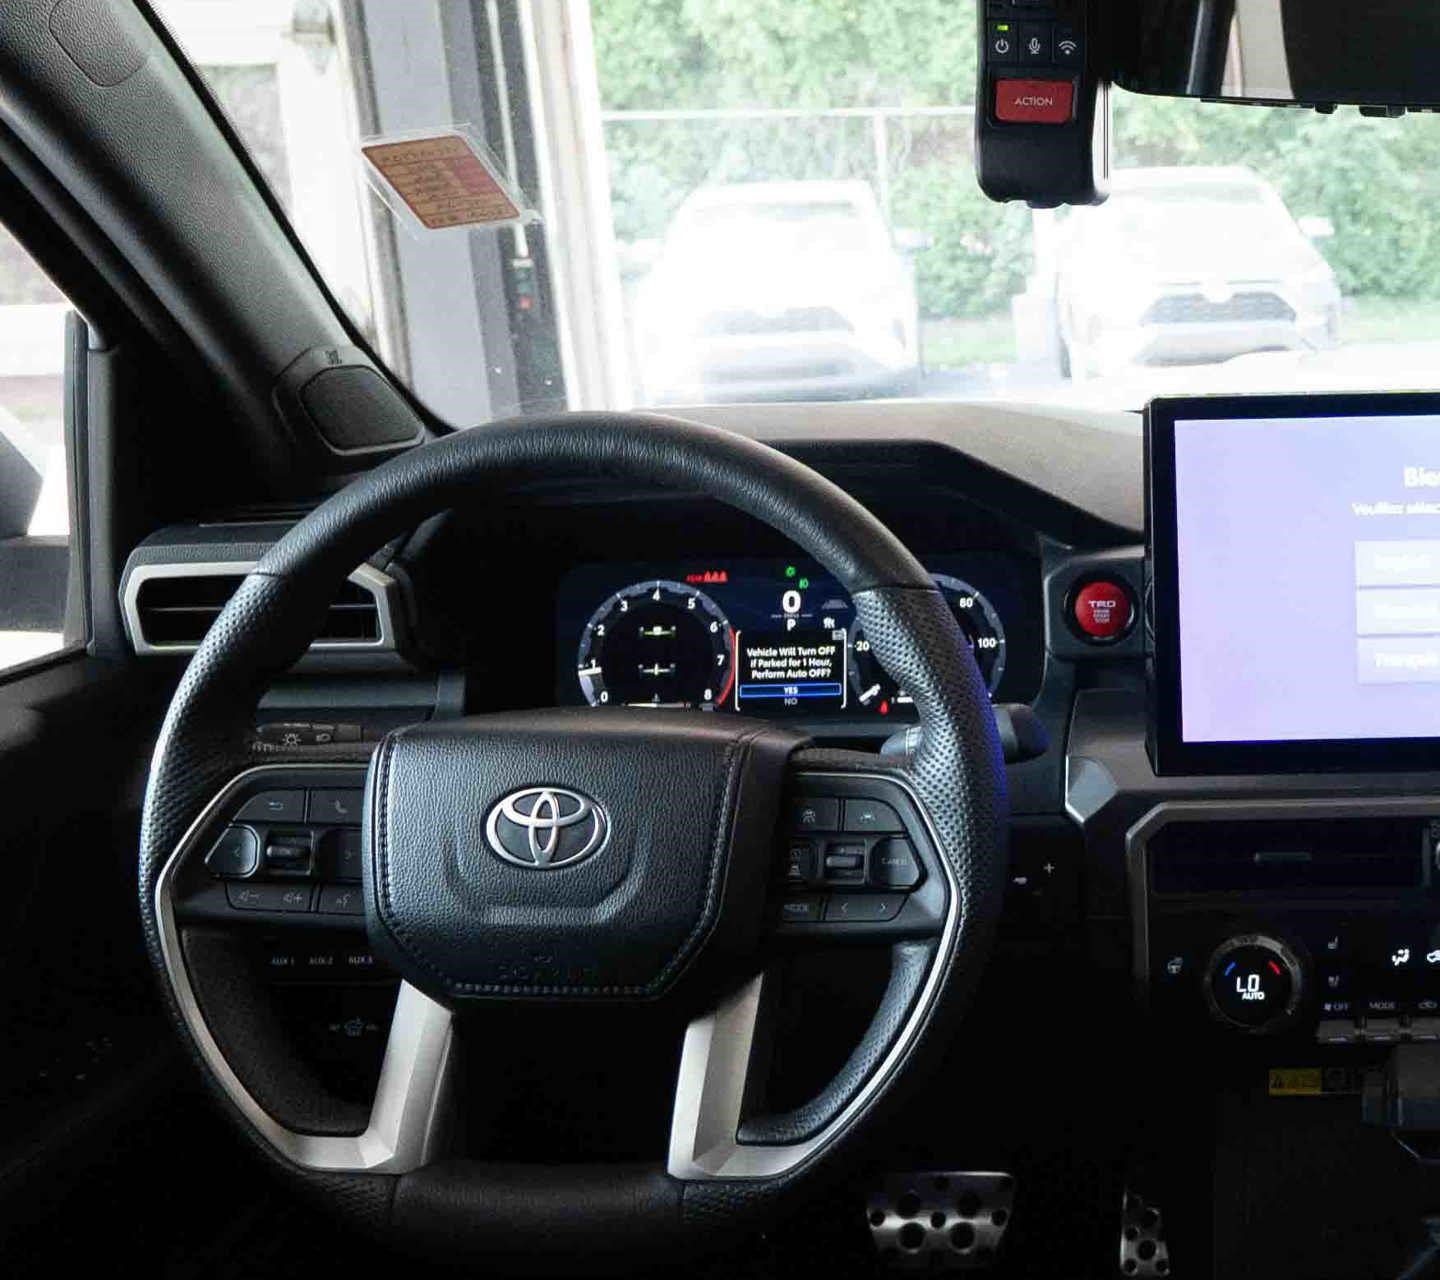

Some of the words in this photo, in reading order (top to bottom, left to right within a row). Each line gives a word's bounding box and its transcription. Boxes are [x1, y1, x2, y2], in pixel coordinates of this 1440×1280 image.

[1013, 96, 1054, 107] ACTION
[652, 589, 660, 601] 4
[620, 600, 628, 612] 3
[687, 598, 696, 609] 5
[782, 590, 801, 613] 0
[1088, 600, 1116, 608] TRD
[597, 625, 605, 636] 2
[710, 622, 718, 633] 6
[786, 619, 797, 631] P
[856, 641, 870, 651] 20
[977, 638, 996, 648] 100
[746, 647, 778, 657] Vehicle
[779, 646, 796, 657] Will
[797, 647, 816, 656] Turn
[817, 645, 836, 656] OFF
[716, 654, 725, 666] 7
[758, 658, 787, 668] Parked
[788, 657, 801, 667] for
[751, 669, 785, 680] Perform
[786, 668, 807, 679] Auto
[808, 668, 832, 678] OFF?
[704, 689, 712, 700] 8
[783, 686, 798, 695] YES
[600, 691, 609, 703] 0
[784, 698, 798, 706] NO
[1235, 973, 1260, 993] LO
[1241, 991, 1266, 1001] AUTO
